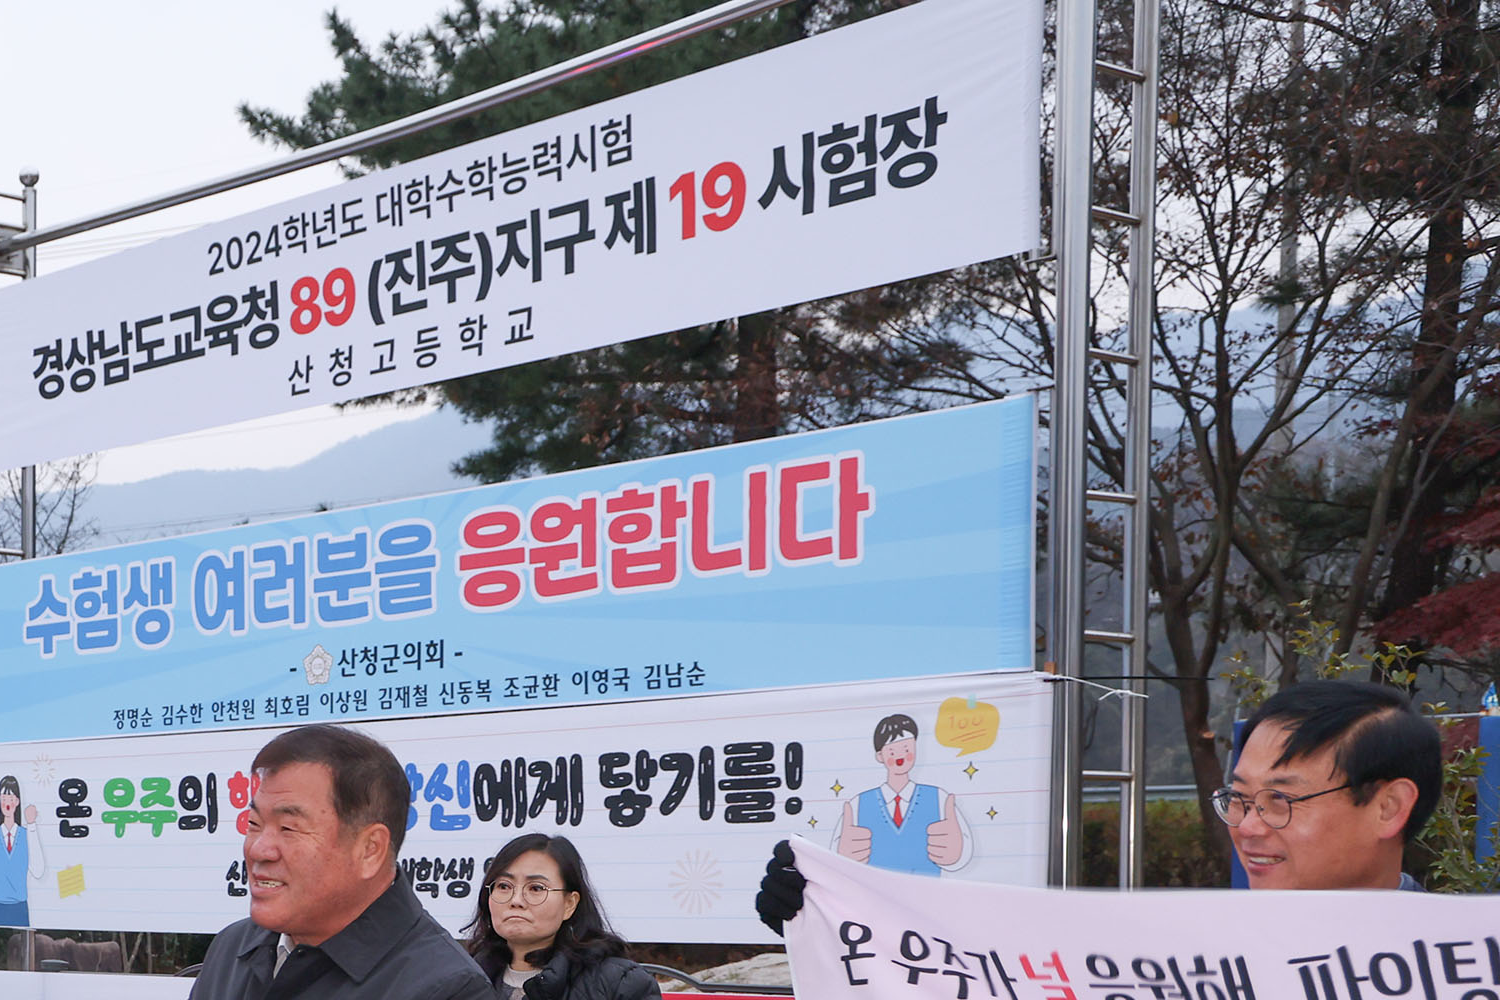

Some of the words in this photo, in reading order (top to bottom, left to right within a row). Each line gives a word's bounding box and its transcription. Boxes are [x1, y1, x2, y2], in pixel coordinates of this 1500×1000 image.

[207, 198, 368, 276] 2024학년도
[375, 113, 633, 228] 대학수학능력시험
[32, 280, 281, 400] 경상남도교육청
[289, 267, 356, 335] 89
[669, 161, 747, 241] 19
[757, 96, 948, 216] 시험장
[24, 559, 175, 657] 수험생
[193, 523, 437, 632] 여러분을
[458, 456, 870, 608] 응원합니다
[112, 707, 153, 730] 정명순
[161, 702, 204, 726] 김수한
[211, 698, 255, 722] 안천원
[264, 694, 310, 718] 최호림
[320, 689, 368, 714] 이상원
[377, 684, 428, 711] 김재철
[438, 678, 492, 706] 신동복
[503, 672, 561, 700] 조균환
[571, 667, 631, 695] 이영국
[644, 661, 706, 690] 김남순
[337, 639, 446, 678] 산청군의회
[56, 777, 93, 839] 온
[101, 772, 218, 839] 우주의
[599, 741, 804, 828] 닿기를!
[839, 920, 876, 986] 온
